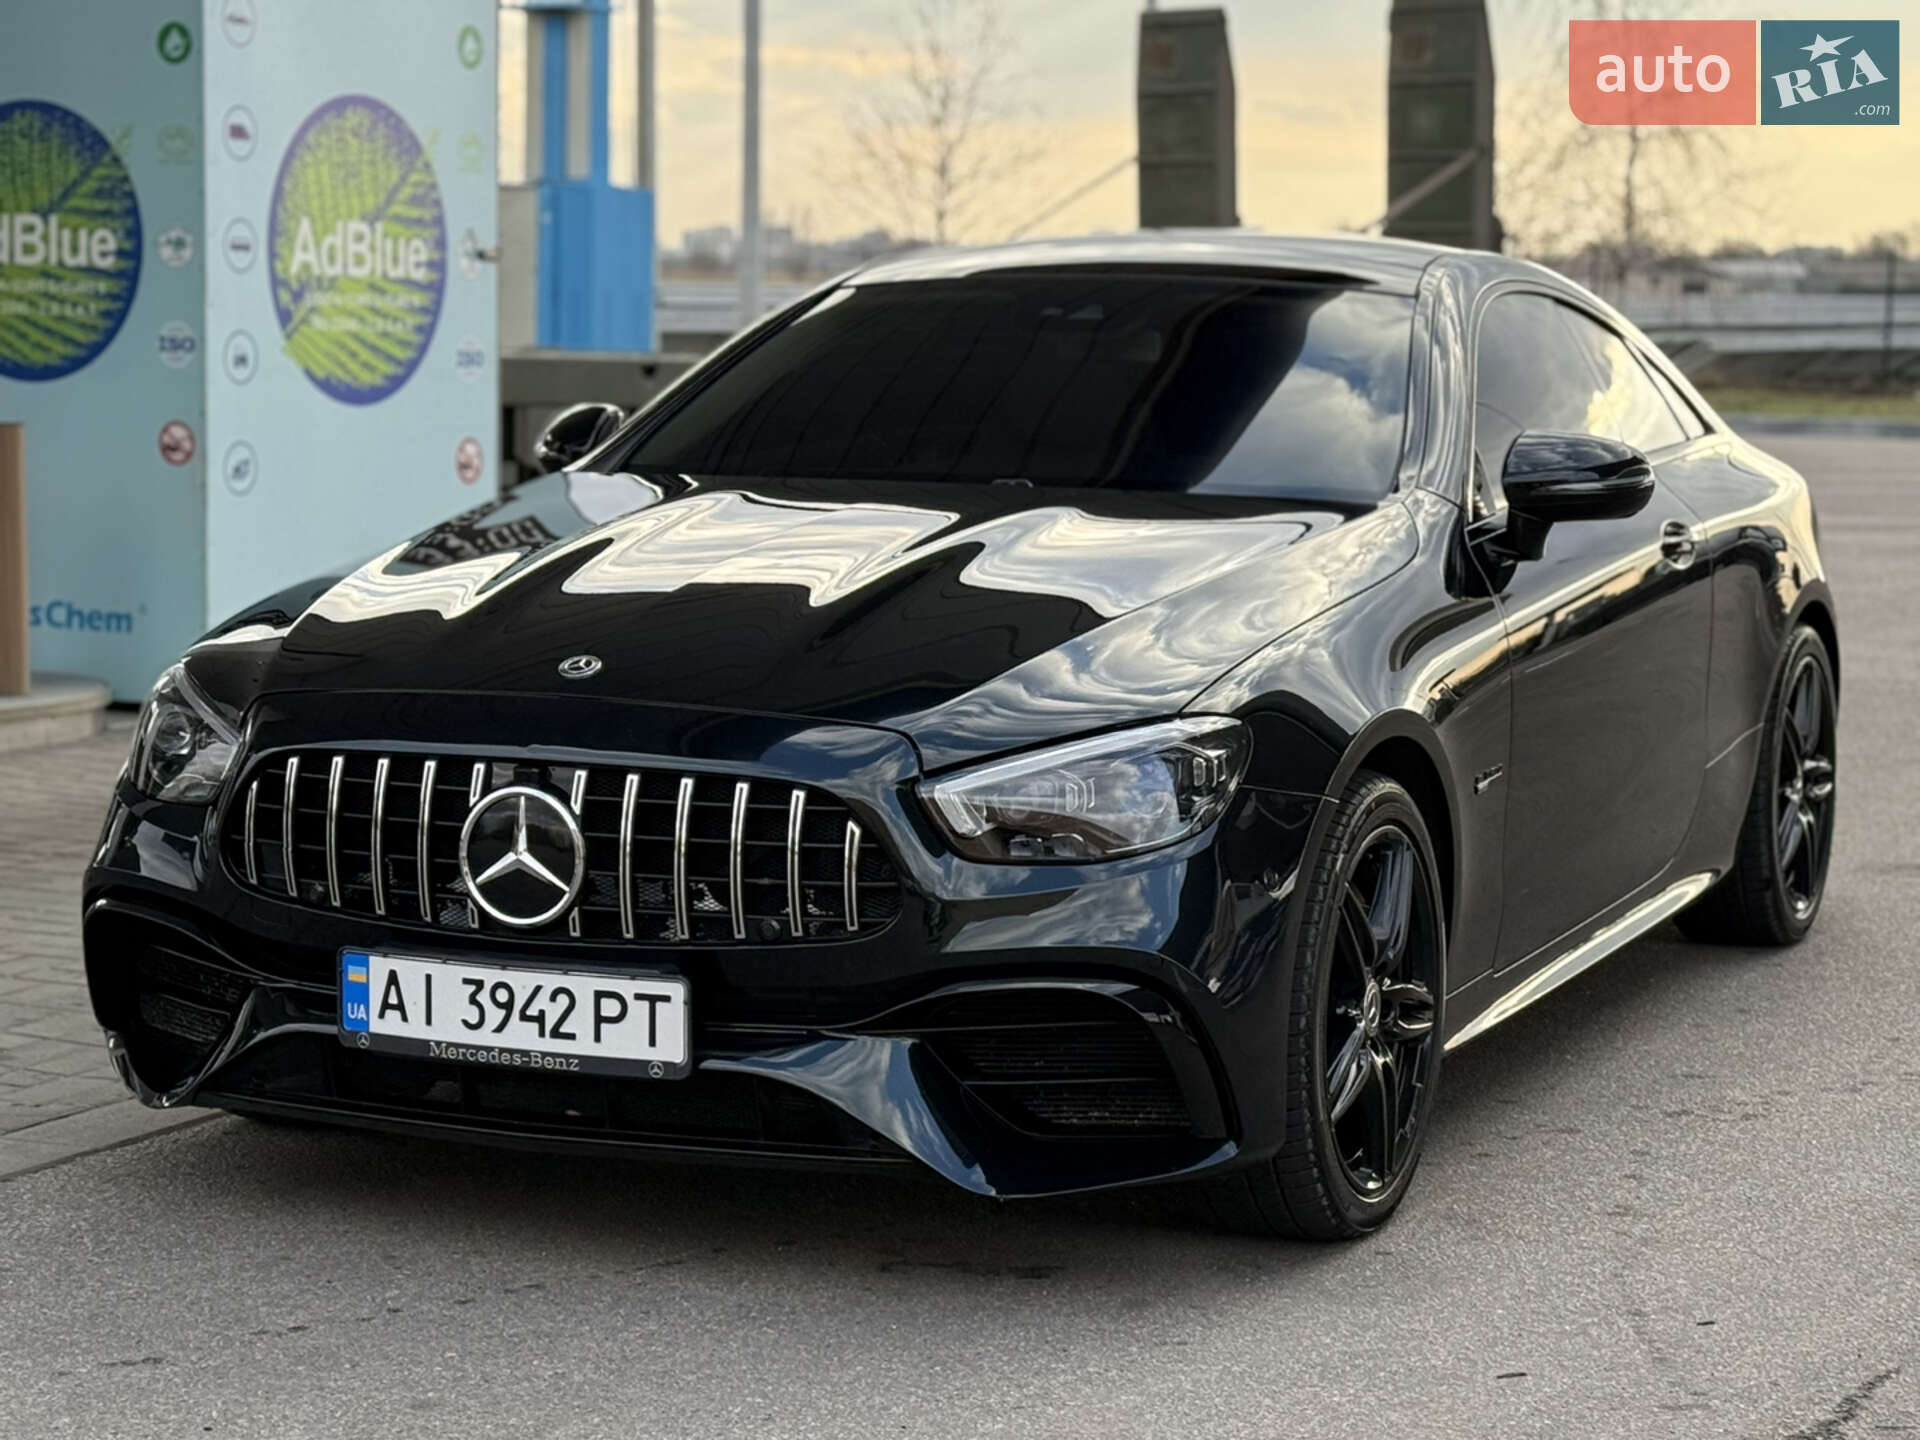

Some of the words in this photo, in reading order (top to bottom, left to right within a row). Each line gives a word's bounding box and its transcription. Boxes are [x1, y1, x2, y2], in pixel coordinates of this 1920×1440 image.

[289, 216, 428, 281] AdBlue
[158, 335, 196, 353] ISO
[347, 1003, 368, 1021] UA
[378, 968, 433, 1027] AI
[460, 977, 577, 1041] 3942
[593, 989, 673, 1048] PT
[428, 1041, 580, 1071] Mercedes-Benz
